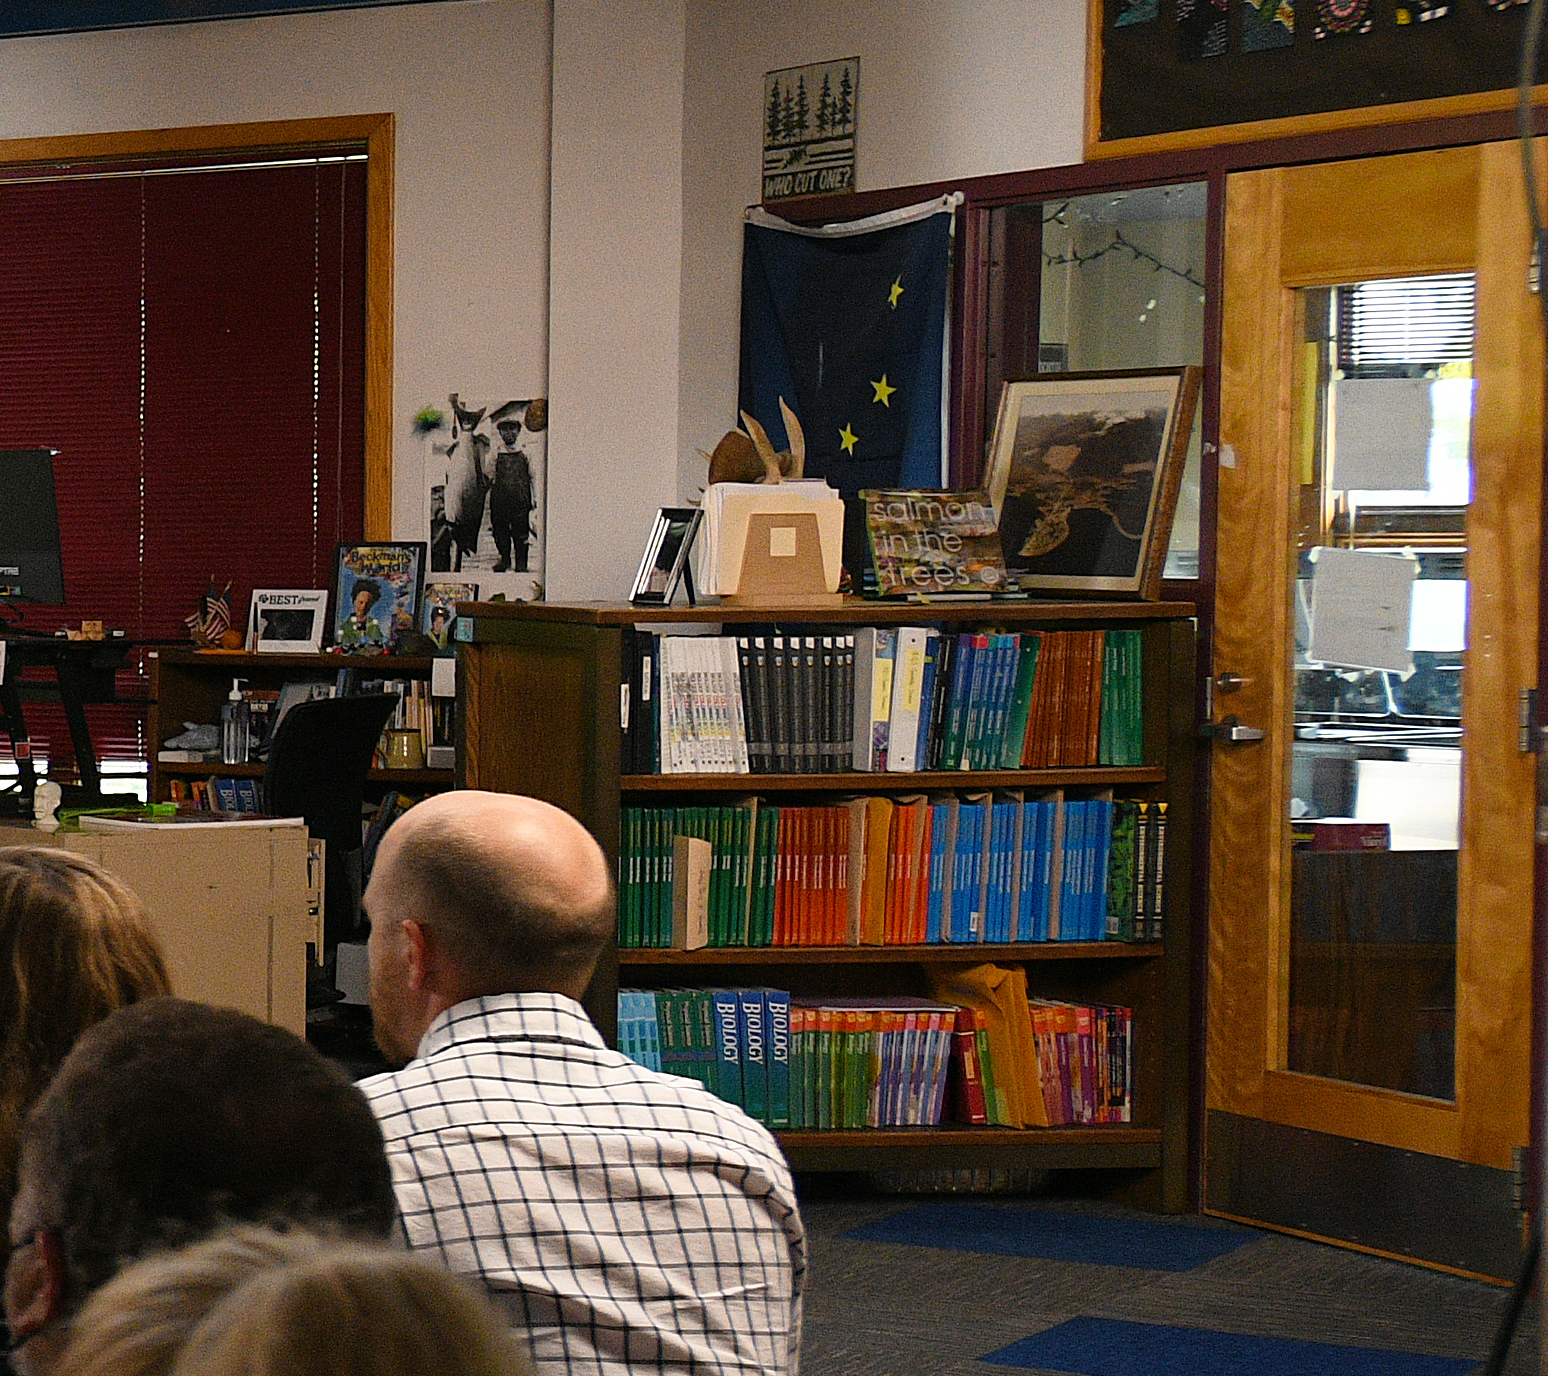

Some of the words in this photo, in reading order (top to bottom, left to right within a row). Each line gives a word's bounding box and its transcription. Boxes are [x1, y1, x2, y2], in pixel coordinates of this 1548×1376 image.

[764, 175, 793, 197] WHO
[795, 170, 818, 193] CUT
[819, 165, 851, 190] ONE?
[873, 497, 987, 522] salmon
[882, 530, 907, 556] in
[912, 528, 963, 553] the
[882, 561, 970, 586] trees
[269, 595, 299, 605] BEST
[716, 1002, 739, 1065] BIOLOGY
[742, 1002, 764, 1065] BIOLOGY
[768, 1001, 788, 1065] BIOLOGY
